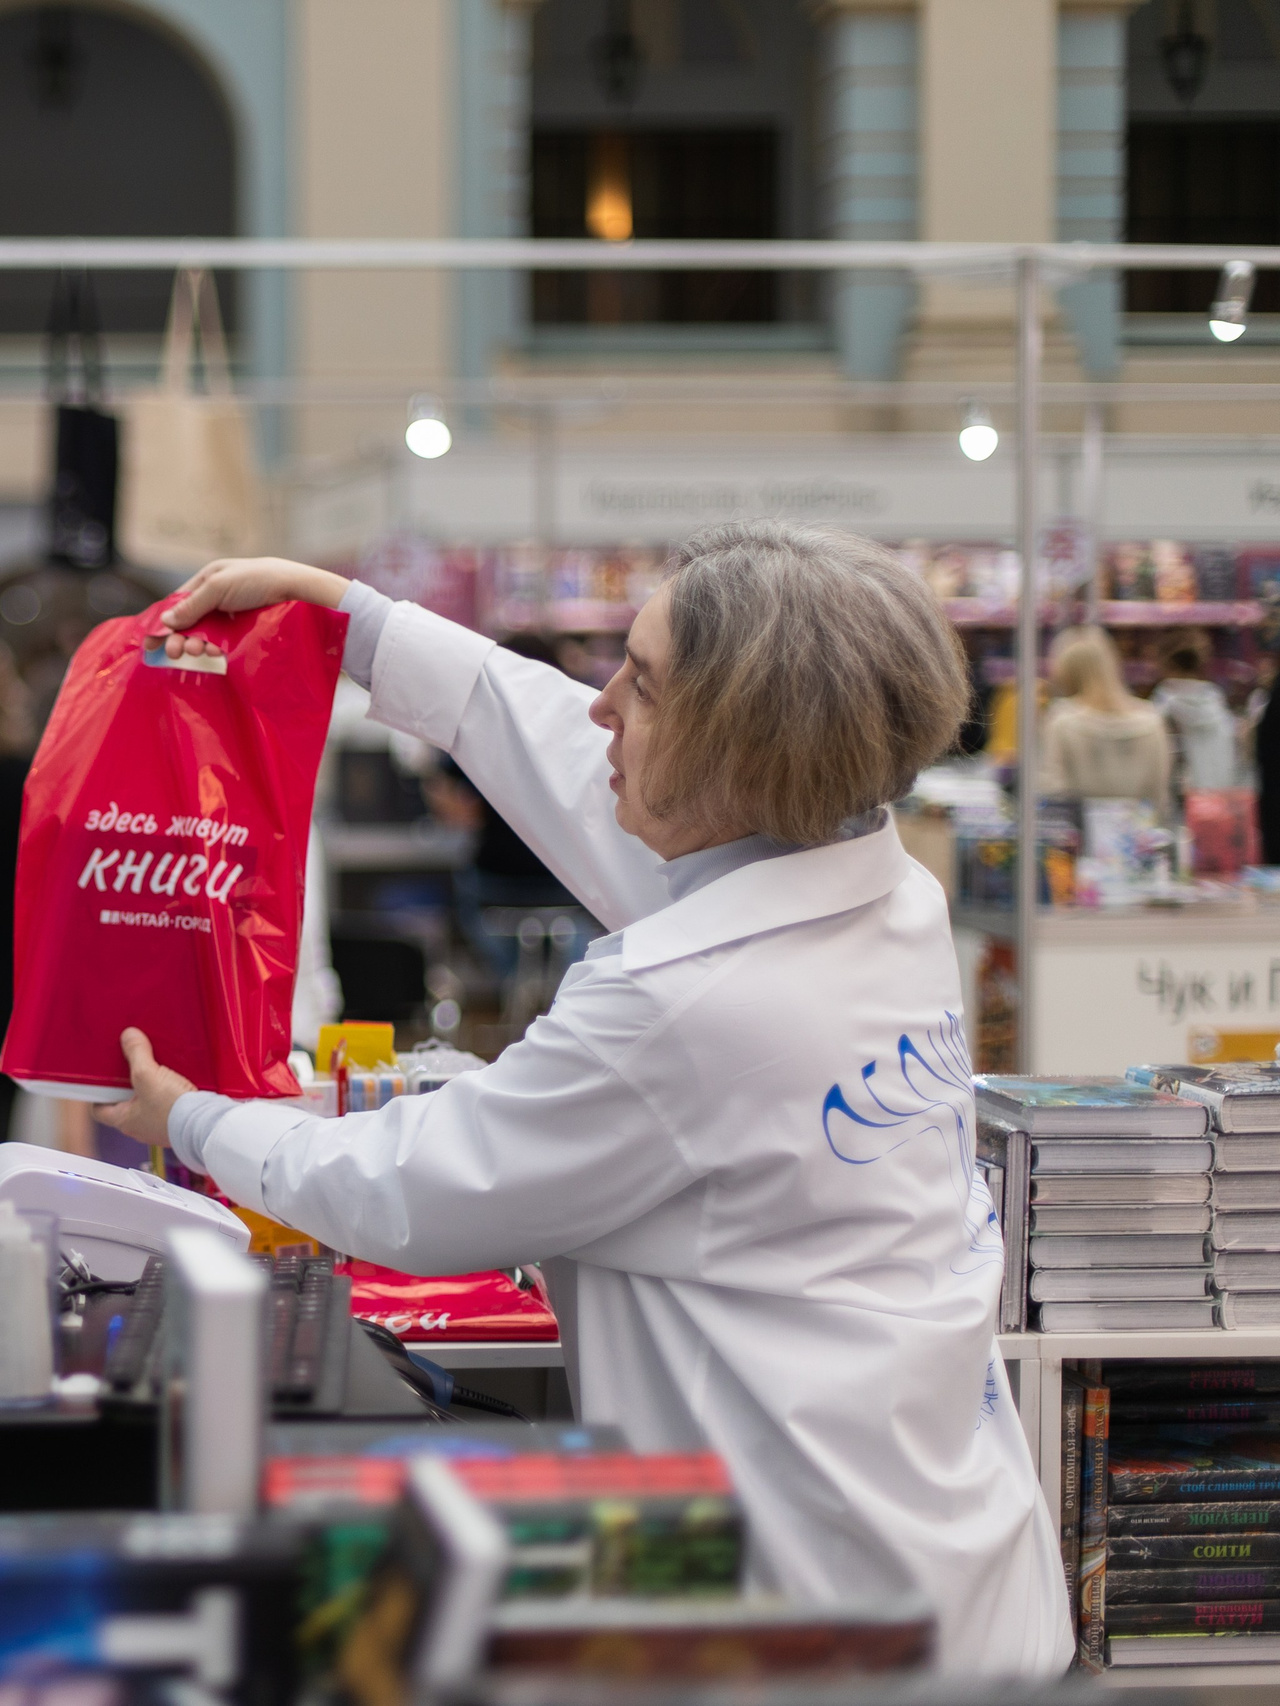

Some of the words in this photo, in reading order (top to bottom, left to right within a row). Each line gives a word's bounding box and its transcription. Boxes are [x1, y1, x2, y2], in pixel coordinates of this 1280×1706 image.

[84, 801, 159, 835] здесь
[165, 814, 250, 847] живут
[1094, 1407, 1105, 1448] УЖАСА
[1065, 1439, 1076, 1509] ФАНТОМНАЯ
[1093, 1452, 1104, 1510] ОСКОЛКИ
[1188, 1511, 1270, 1526] ПЕРЕУЛОК
[1195, 1613, 1264, 1626] СТАТУИ
